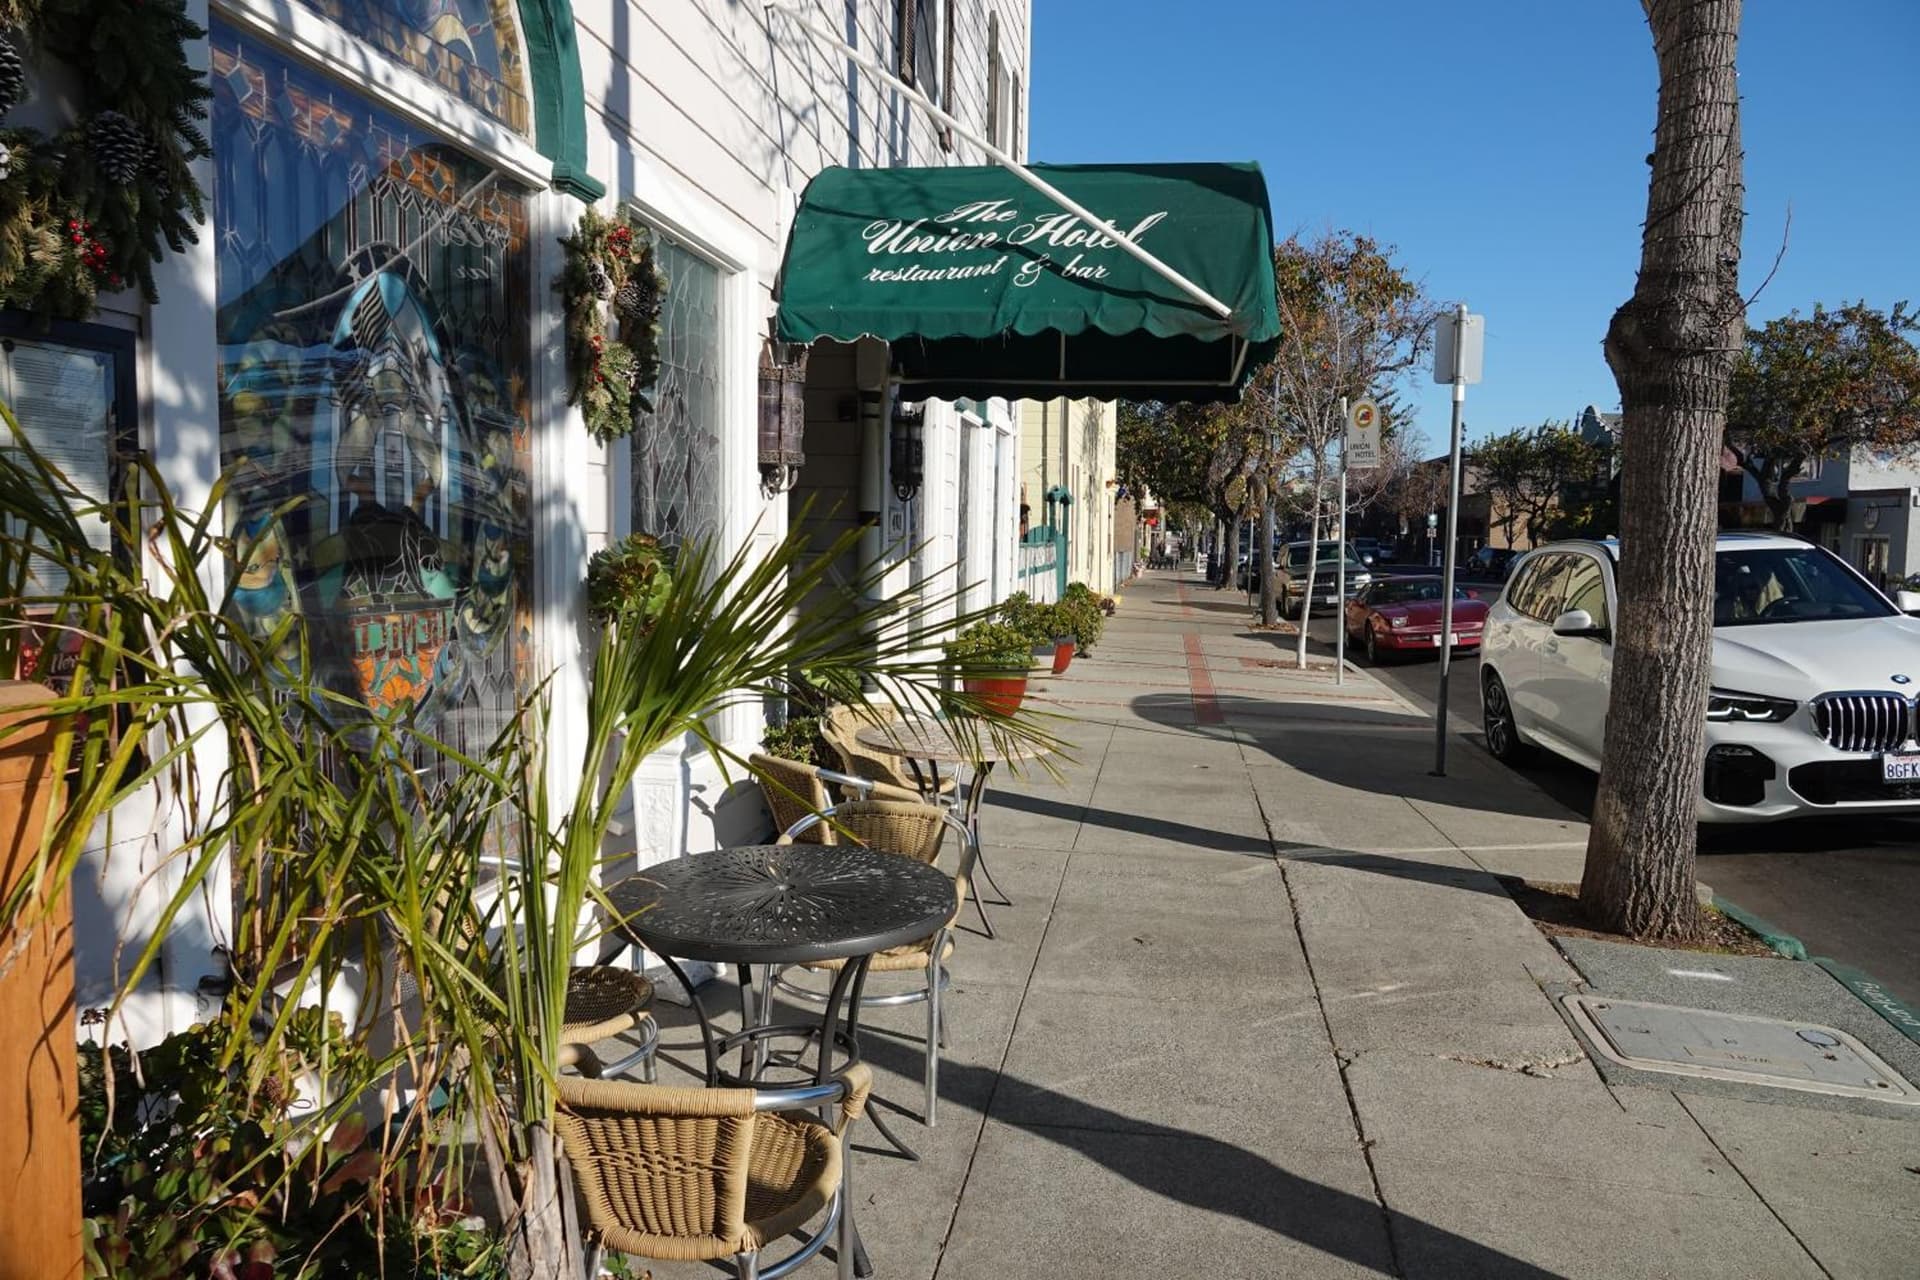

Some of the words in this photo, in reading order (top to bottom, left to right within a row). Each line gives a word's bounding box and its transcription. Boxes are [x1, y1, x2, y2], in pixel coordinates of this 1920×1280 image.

[934, 199, 1018, 223] The
[862, 218, 1002, 254] Union
[1007, 211, 1168, 249] Hotel
[862, 255, 1009, 281] restaurant
[1013, 253, 1050, 287] &
[1062, 254, 1111, 279] bar
